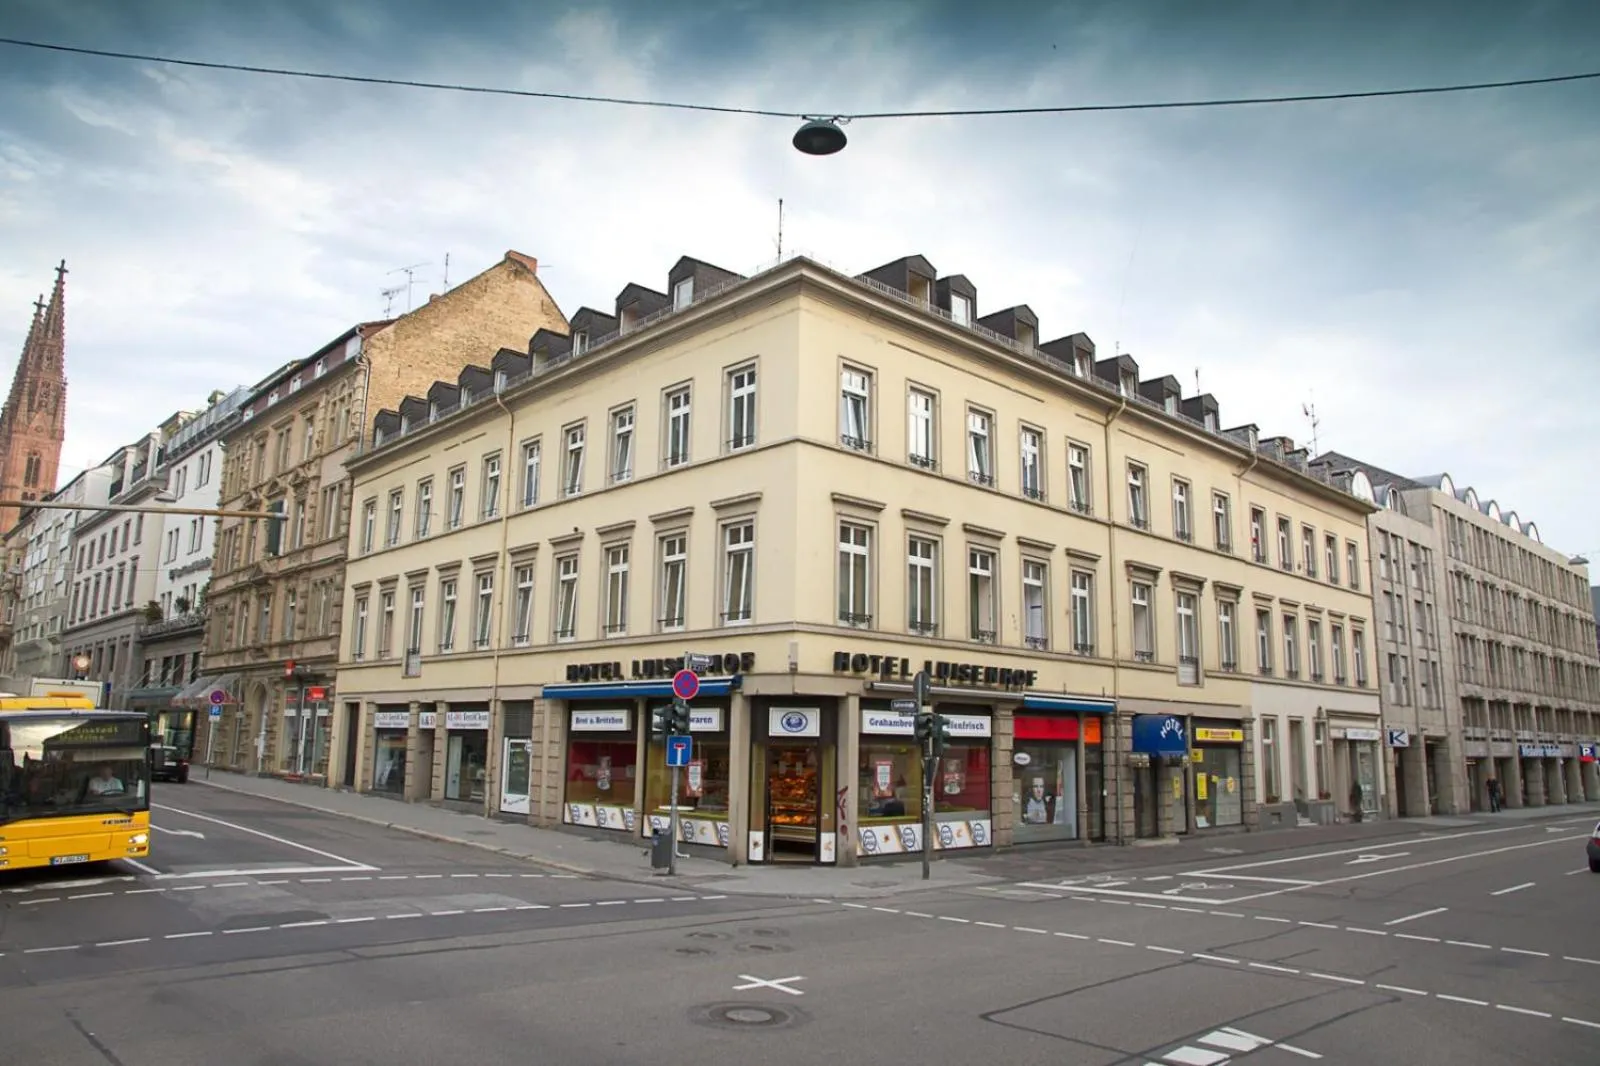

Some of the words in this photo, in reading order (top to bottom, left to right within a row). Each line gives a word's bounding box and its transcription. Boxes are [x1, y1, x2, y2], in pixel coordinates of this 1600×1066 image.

[566, 662, 624, 681] HOTEL
[632, 651, 755, 678] LUISEHOF
[833, 651, 913, 676] HOTEL
[924, 660, 1038, 687] LUISENHOF
[869, 717, 914, 728] Grahambro
[1160, 718, 1184, 740] HOTEL
[1582, 747, 1591, 757] P
